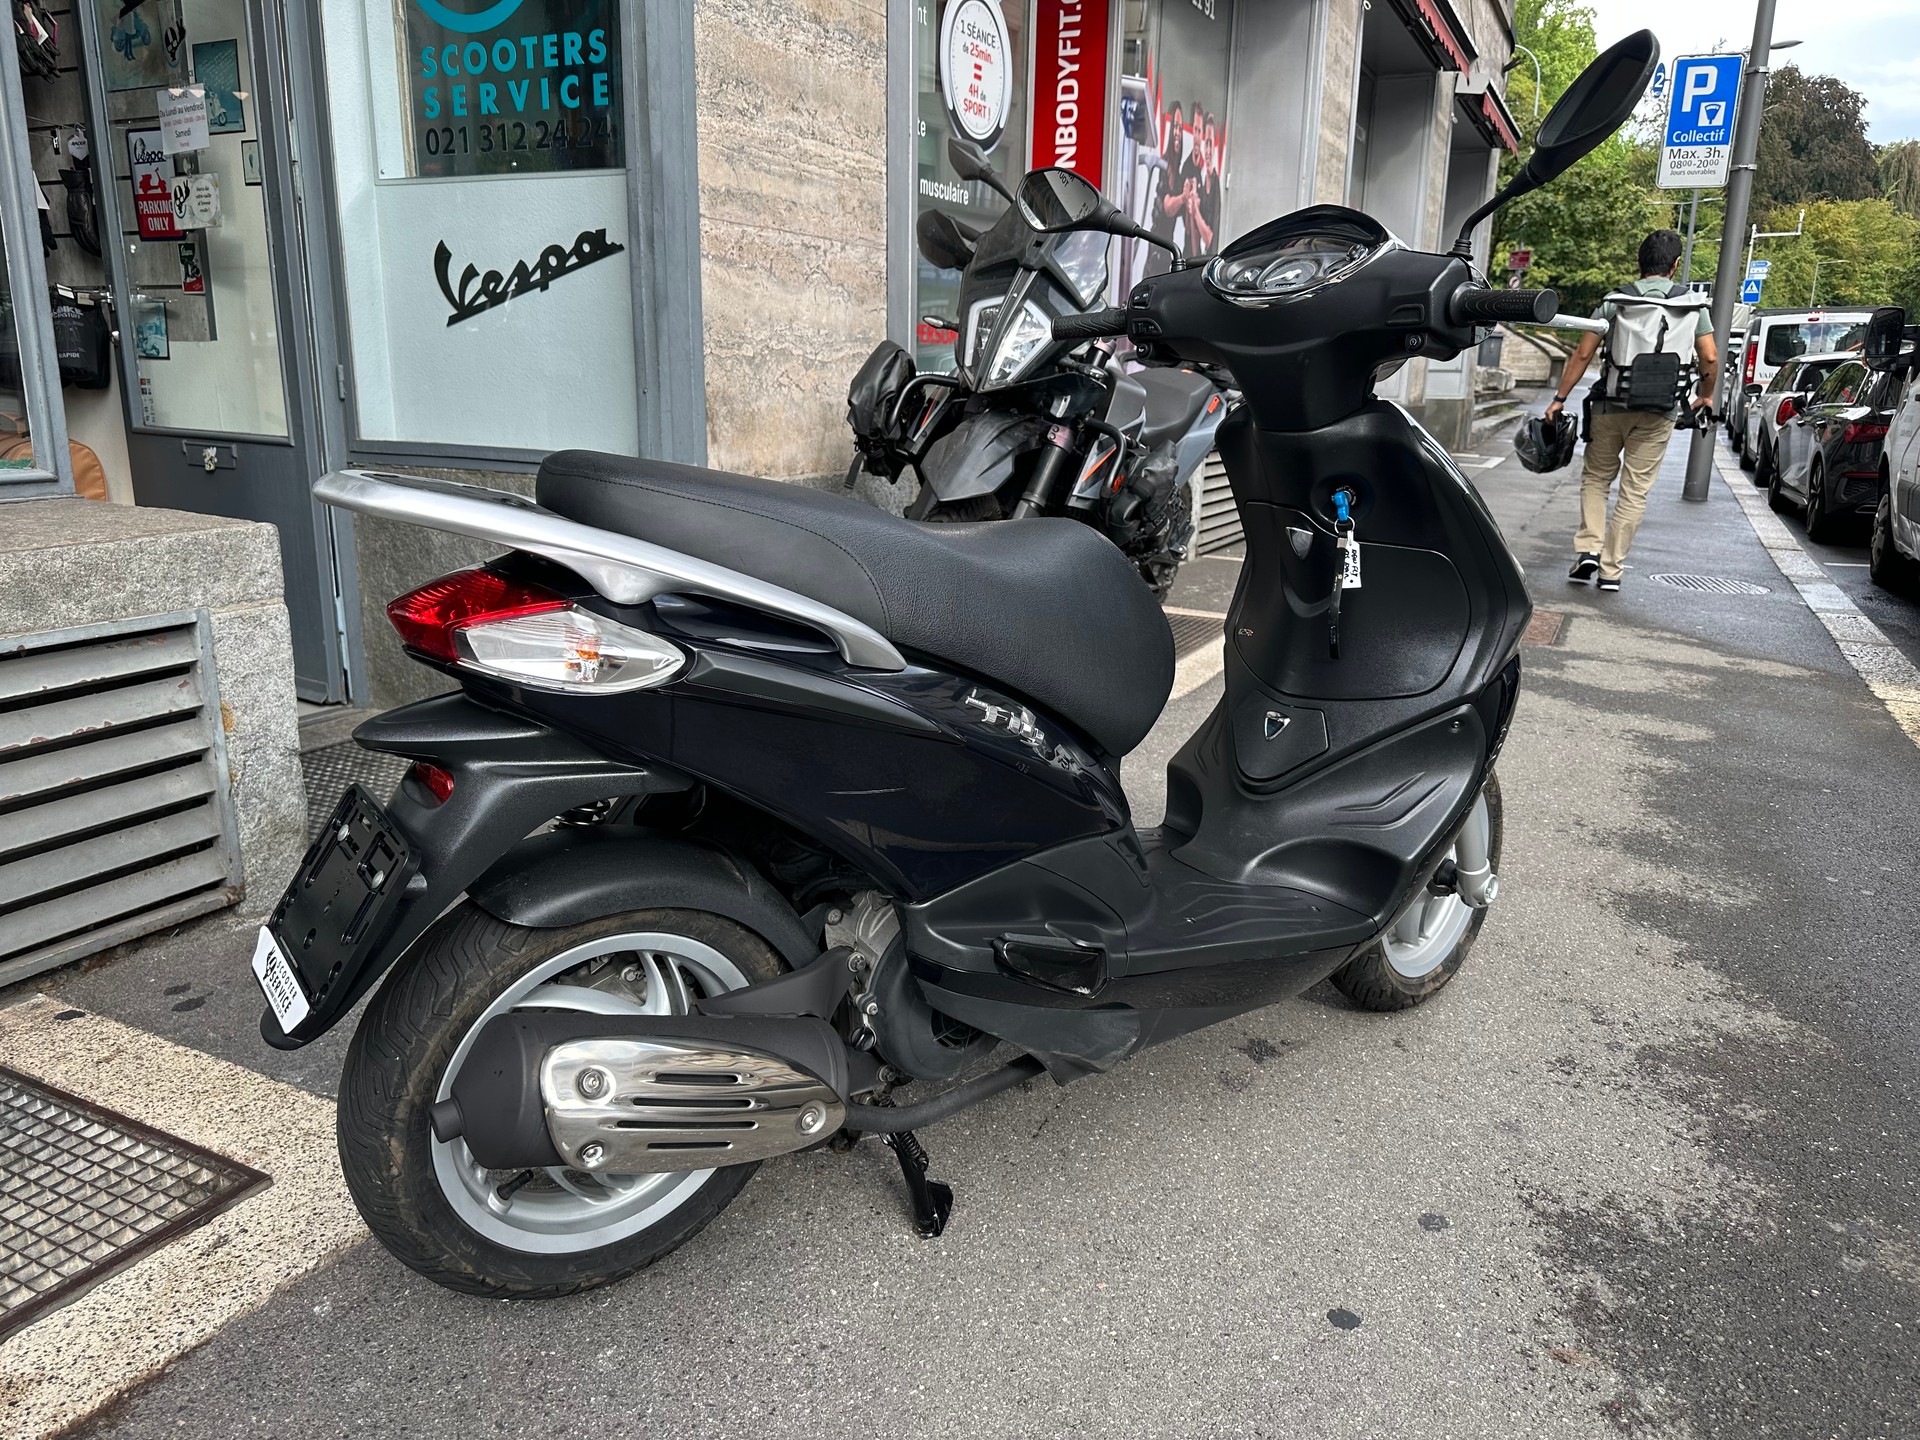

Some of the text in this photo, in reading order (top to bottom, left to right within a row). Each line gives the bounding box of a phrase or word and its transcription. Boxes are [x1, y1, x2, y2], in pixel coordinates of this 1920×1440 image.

[960, 20, 996, 49] 1 SÉANCE
[963, 42, 969, 54] de
[421, 29, 607, 79] SCOOTERS
[424, 72, 609, 119] SERVICE
[968, 83, 979, 99] 4H
[1054, 0, 1082, 169] NBODYFIT.
[1681, 66, 1718, 112] P
[165, 107, 177, 117] Lundi
[184, 101, 204, 113] Vendredi
[963, 98, 987, 119] SPORT
[175, 128, 191, 138] Samedi
[425, 117, 612, 156] 021 312 24 24
[1672, 128, 1725, 143] Collectif
[134, 137, 166, 166] Vespa
[1669, 146, 1724, 160] Max. 3h.
[1687, 168, 1716, 176] ouvrables
[920, 178, 969, 206] musculaire
[147, 217, 169, 232] ONLY
[433, 228, 625, 327] Vespa
[269, 971, 291, 1013] SERVICE
[276, 961, 297, 1000] SCOOTER
